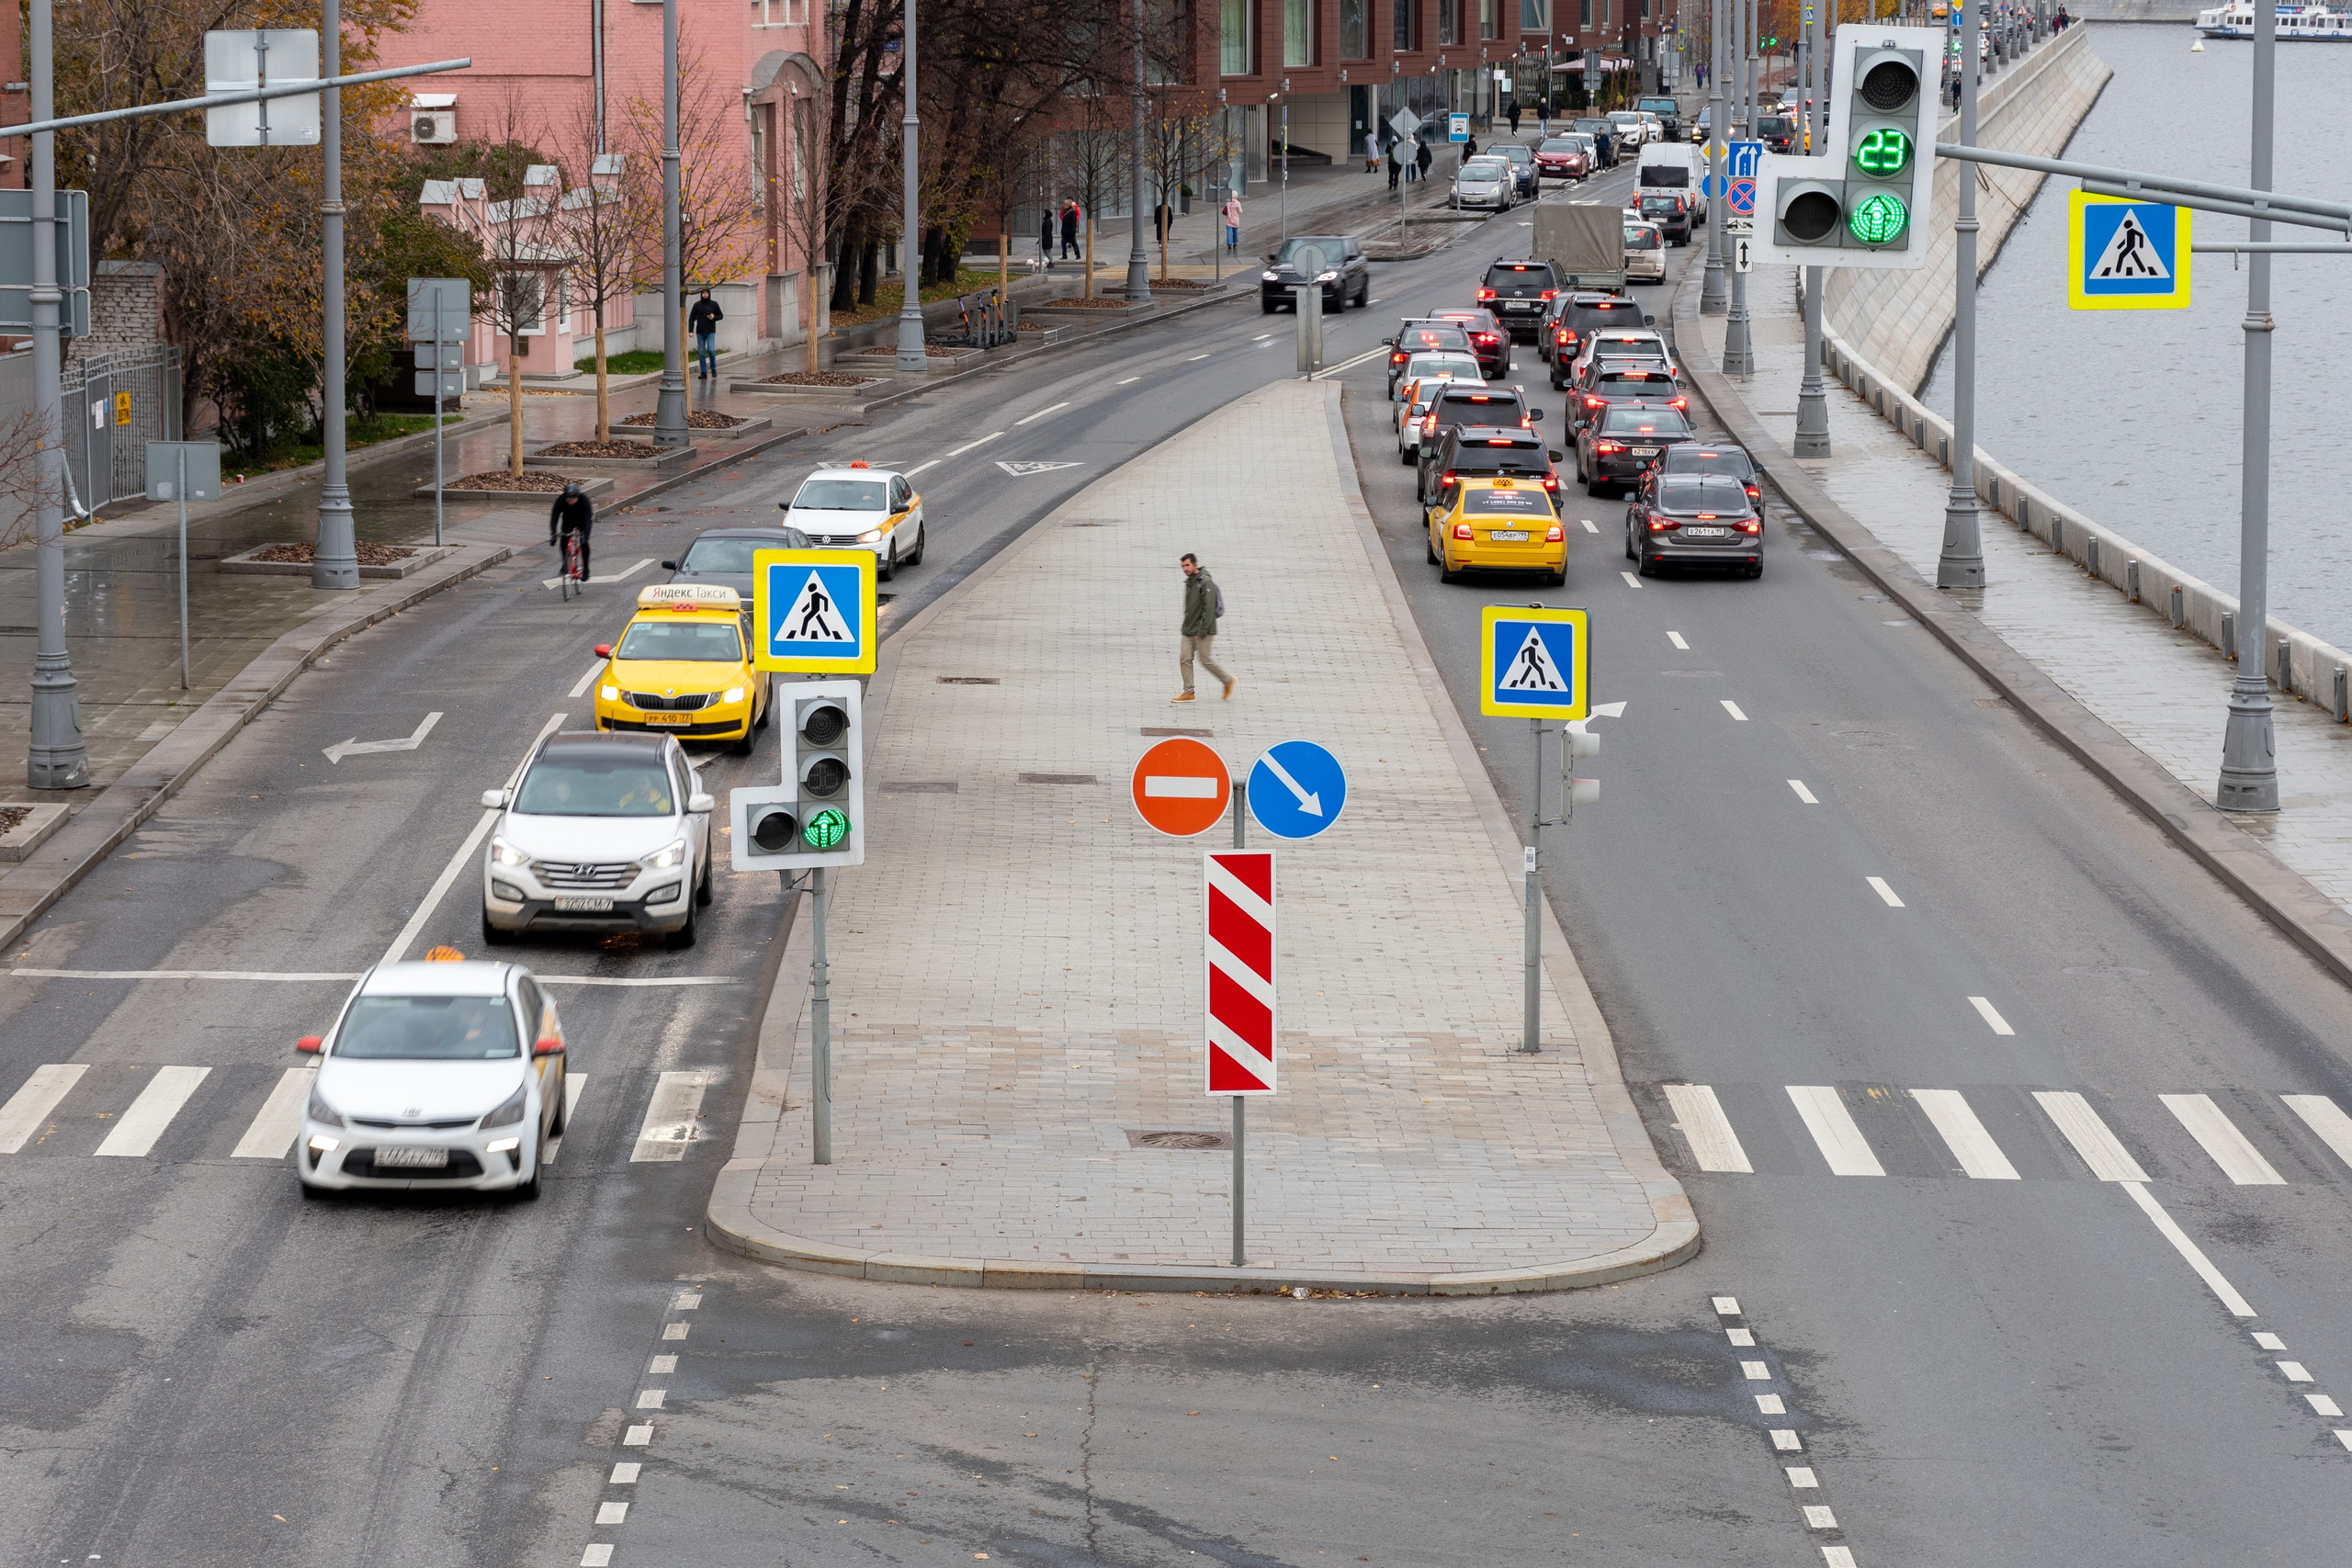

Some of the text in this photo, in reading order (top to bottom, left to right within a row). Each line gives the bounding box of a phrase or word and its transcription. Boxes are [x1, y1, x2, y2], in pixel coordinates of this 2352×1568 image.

[1860, 130, 1904, 168] 23
[652, 587, 726, 599] Яндекс Такси
[662, 714, 677, 723] 410
